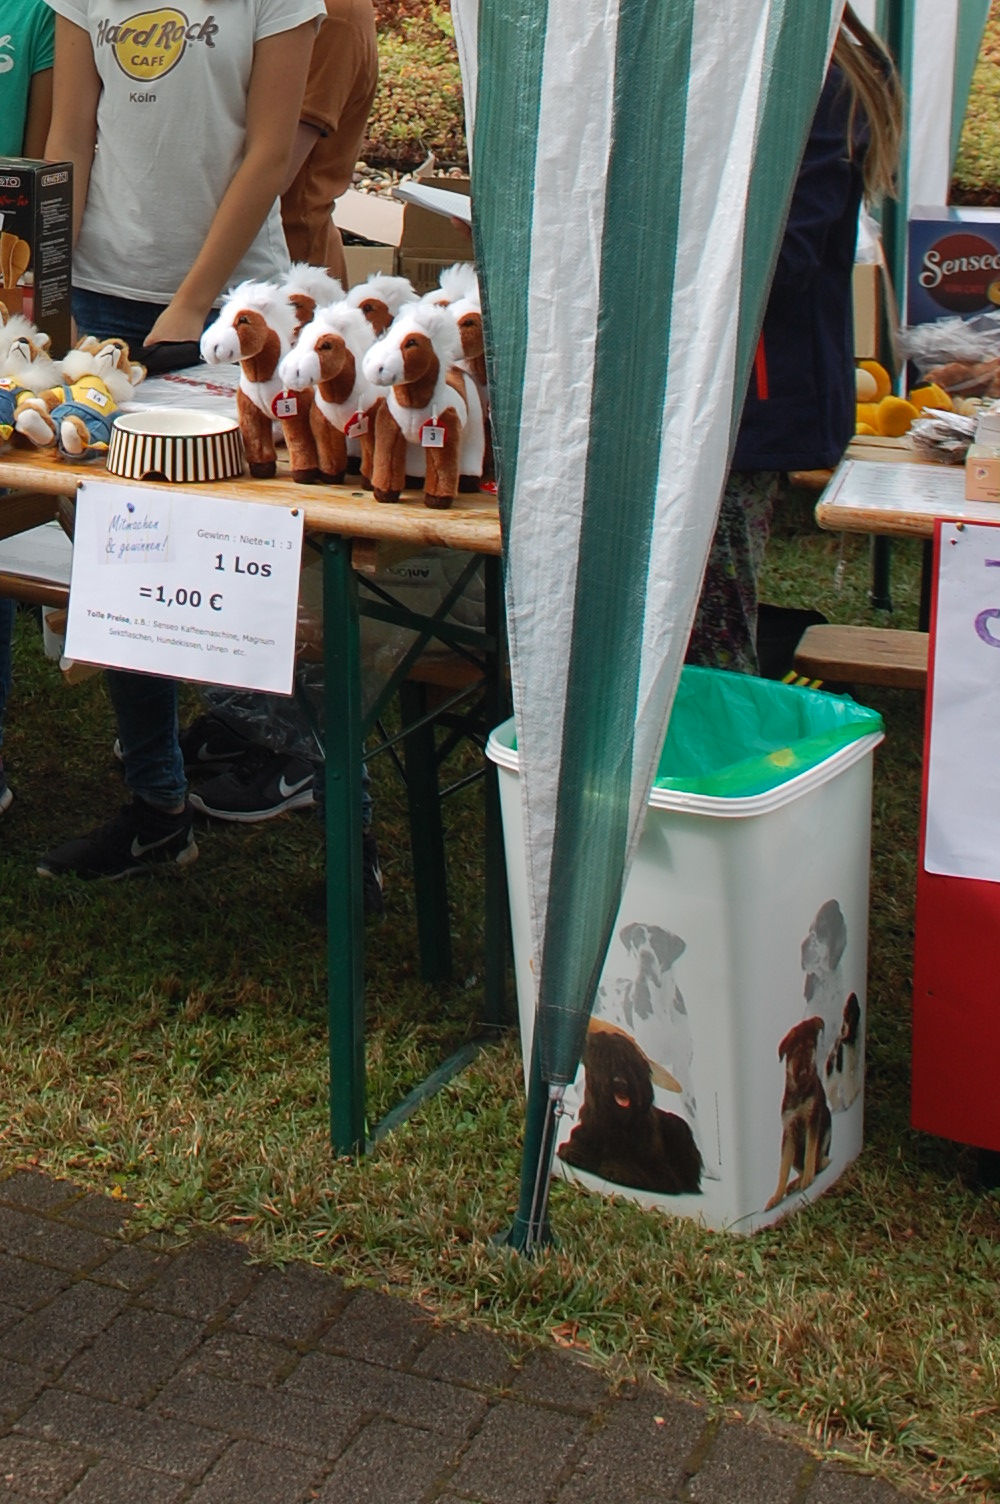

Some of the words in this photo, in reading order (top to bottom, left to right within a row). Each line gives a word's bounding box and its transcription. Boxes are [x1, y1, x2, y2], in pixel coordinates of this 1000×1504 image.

[96, 18, 158, 48] Hard
[155, 15, 219, 50] Rock
[130, 55, 165, 67] CAFE
[129, 92, 157, 103] Köln
[430, 432, 436, 441] 3
[197, 529, 230, 541] Gewinn
[214, 553, 225, 571] 1
[234, 556, 272, 578] Los
[209, 593, 223, 611] €
[87, 609, 105, 619] Tolle
[206, 643, 228, 653] Uhren
